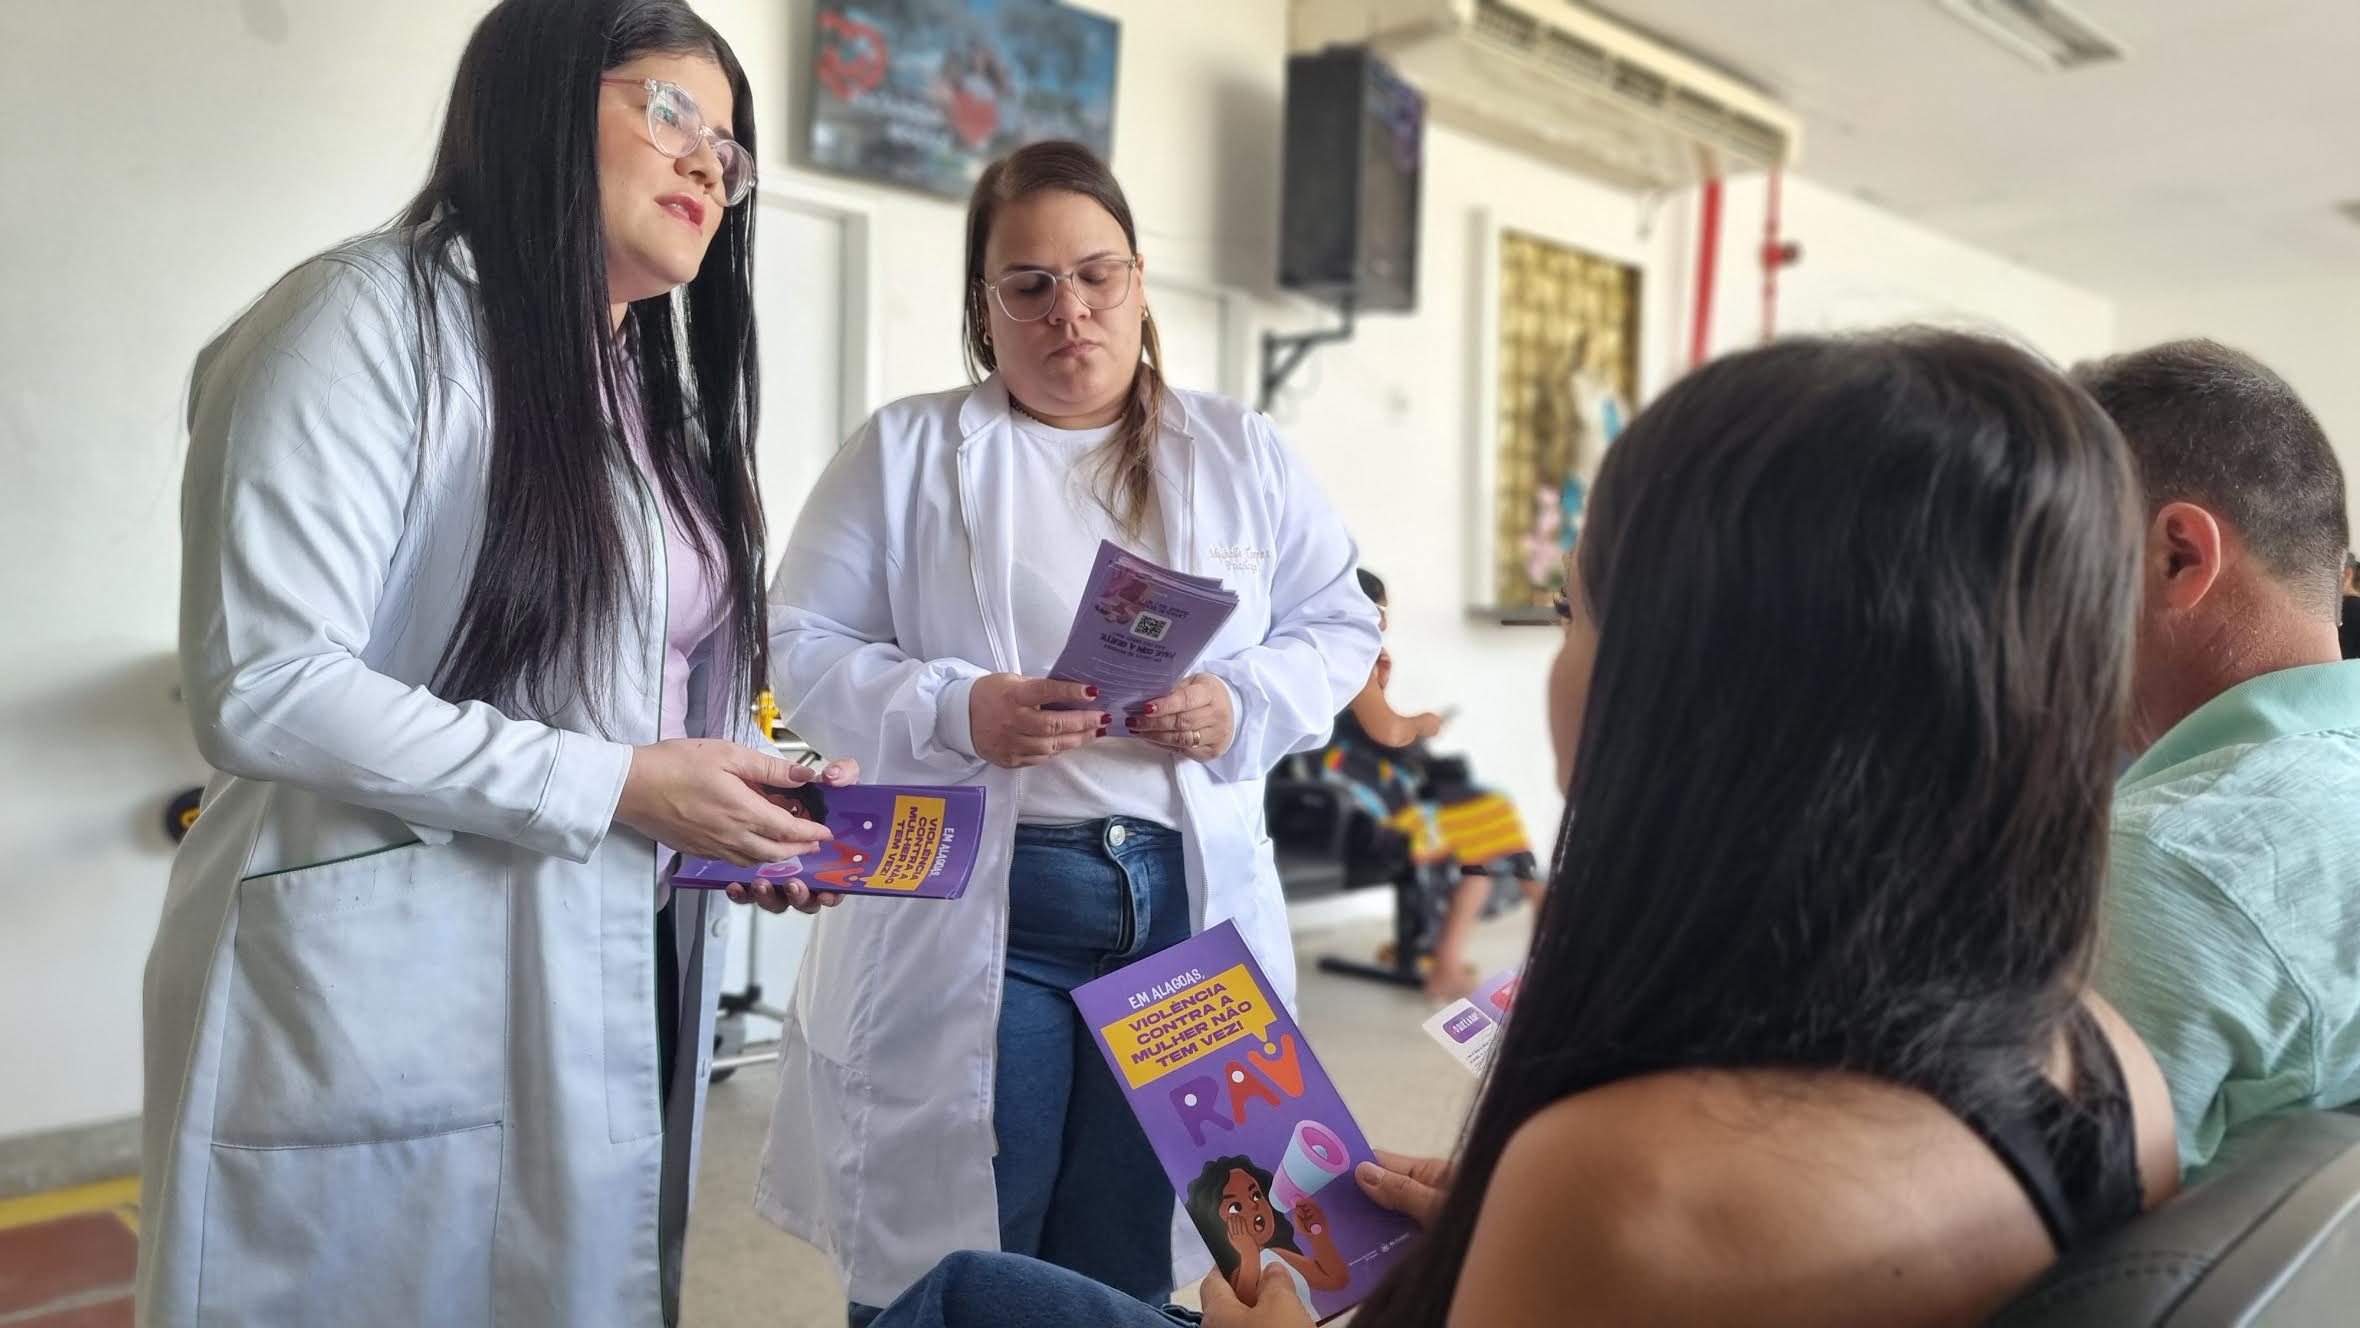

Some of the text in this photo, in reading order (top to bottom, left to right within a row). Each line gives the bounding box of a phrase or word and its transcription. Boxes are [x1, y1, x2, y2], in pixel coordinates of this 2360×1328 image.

[891, 820, 905, 850] TEM
[898, 806, 918, 863] MULHER
[905, 816, 928, 871] CONTRA
[942, 827, 955, 843] EM
[1128, 968, 1205, 1010] EM ALAGOAS,
[1128, 983, 1227, 1032] VIOLÊNCIA
[1130, 1000, 1253, 1065] MULHER NÃO
[1136, 994, 1234, 1046] CONTRA A
[1155, 1020, 1244, 1068] TEM VEZ!
[1169, 1033, 1305, 1148] RAV
